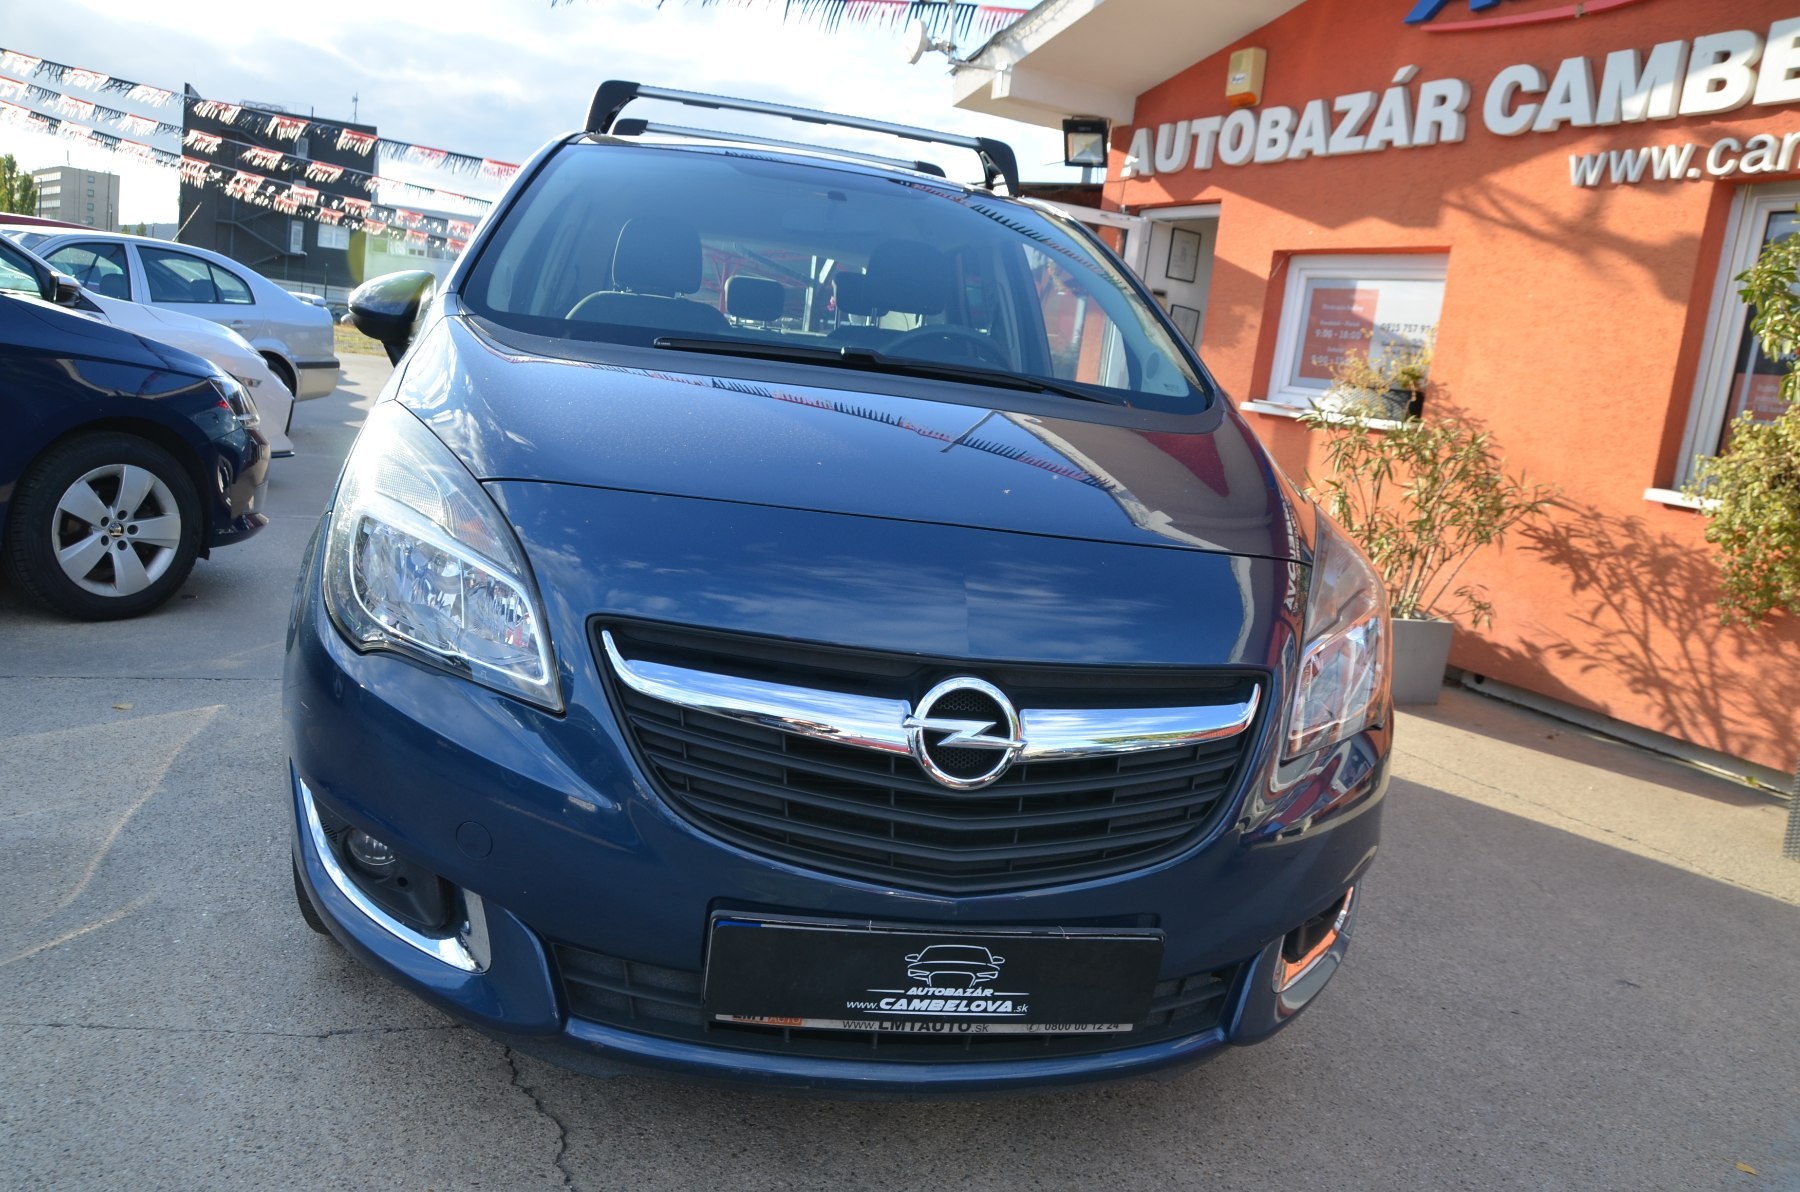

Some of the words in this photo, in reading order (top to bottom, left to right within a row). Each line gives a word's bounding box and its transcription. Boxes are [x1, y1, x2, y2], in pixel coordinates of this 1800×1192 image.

[1120, 64, 1471, 179] AUTOBAZÁR
[1482, 16, 1800, 138] CAMBE
[906, 986, 994, 997] AUTOBAZÁR
[846, 997, 1029, 1013] www.CAMBELOVA.sk
